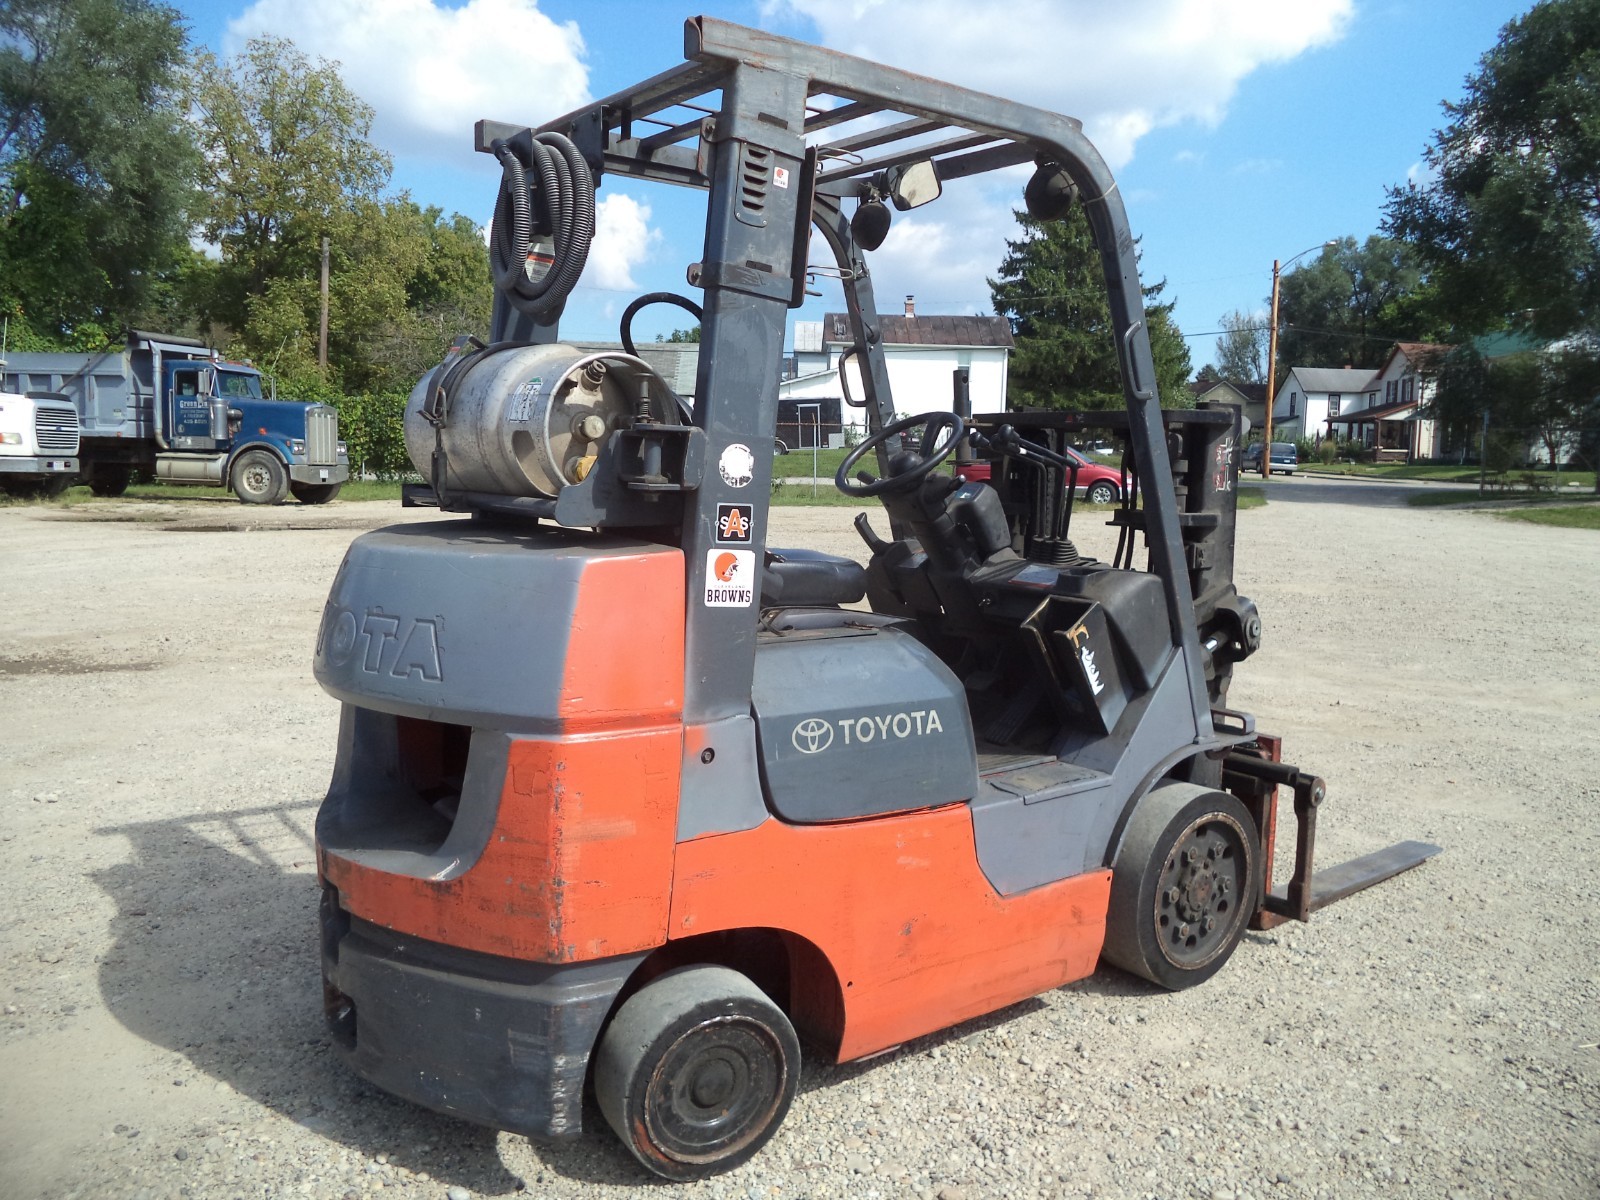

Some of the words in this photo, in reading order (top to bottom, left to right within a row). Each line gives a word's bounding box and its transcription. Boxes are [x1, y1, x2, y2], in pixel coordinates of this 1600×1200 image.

[720, 508, 749, 537] SAS
[707, 589, 751, 602] BROWNS
[318, 604, 443, 683] OTA
[838, 709, 943, 745] TOYOTA
